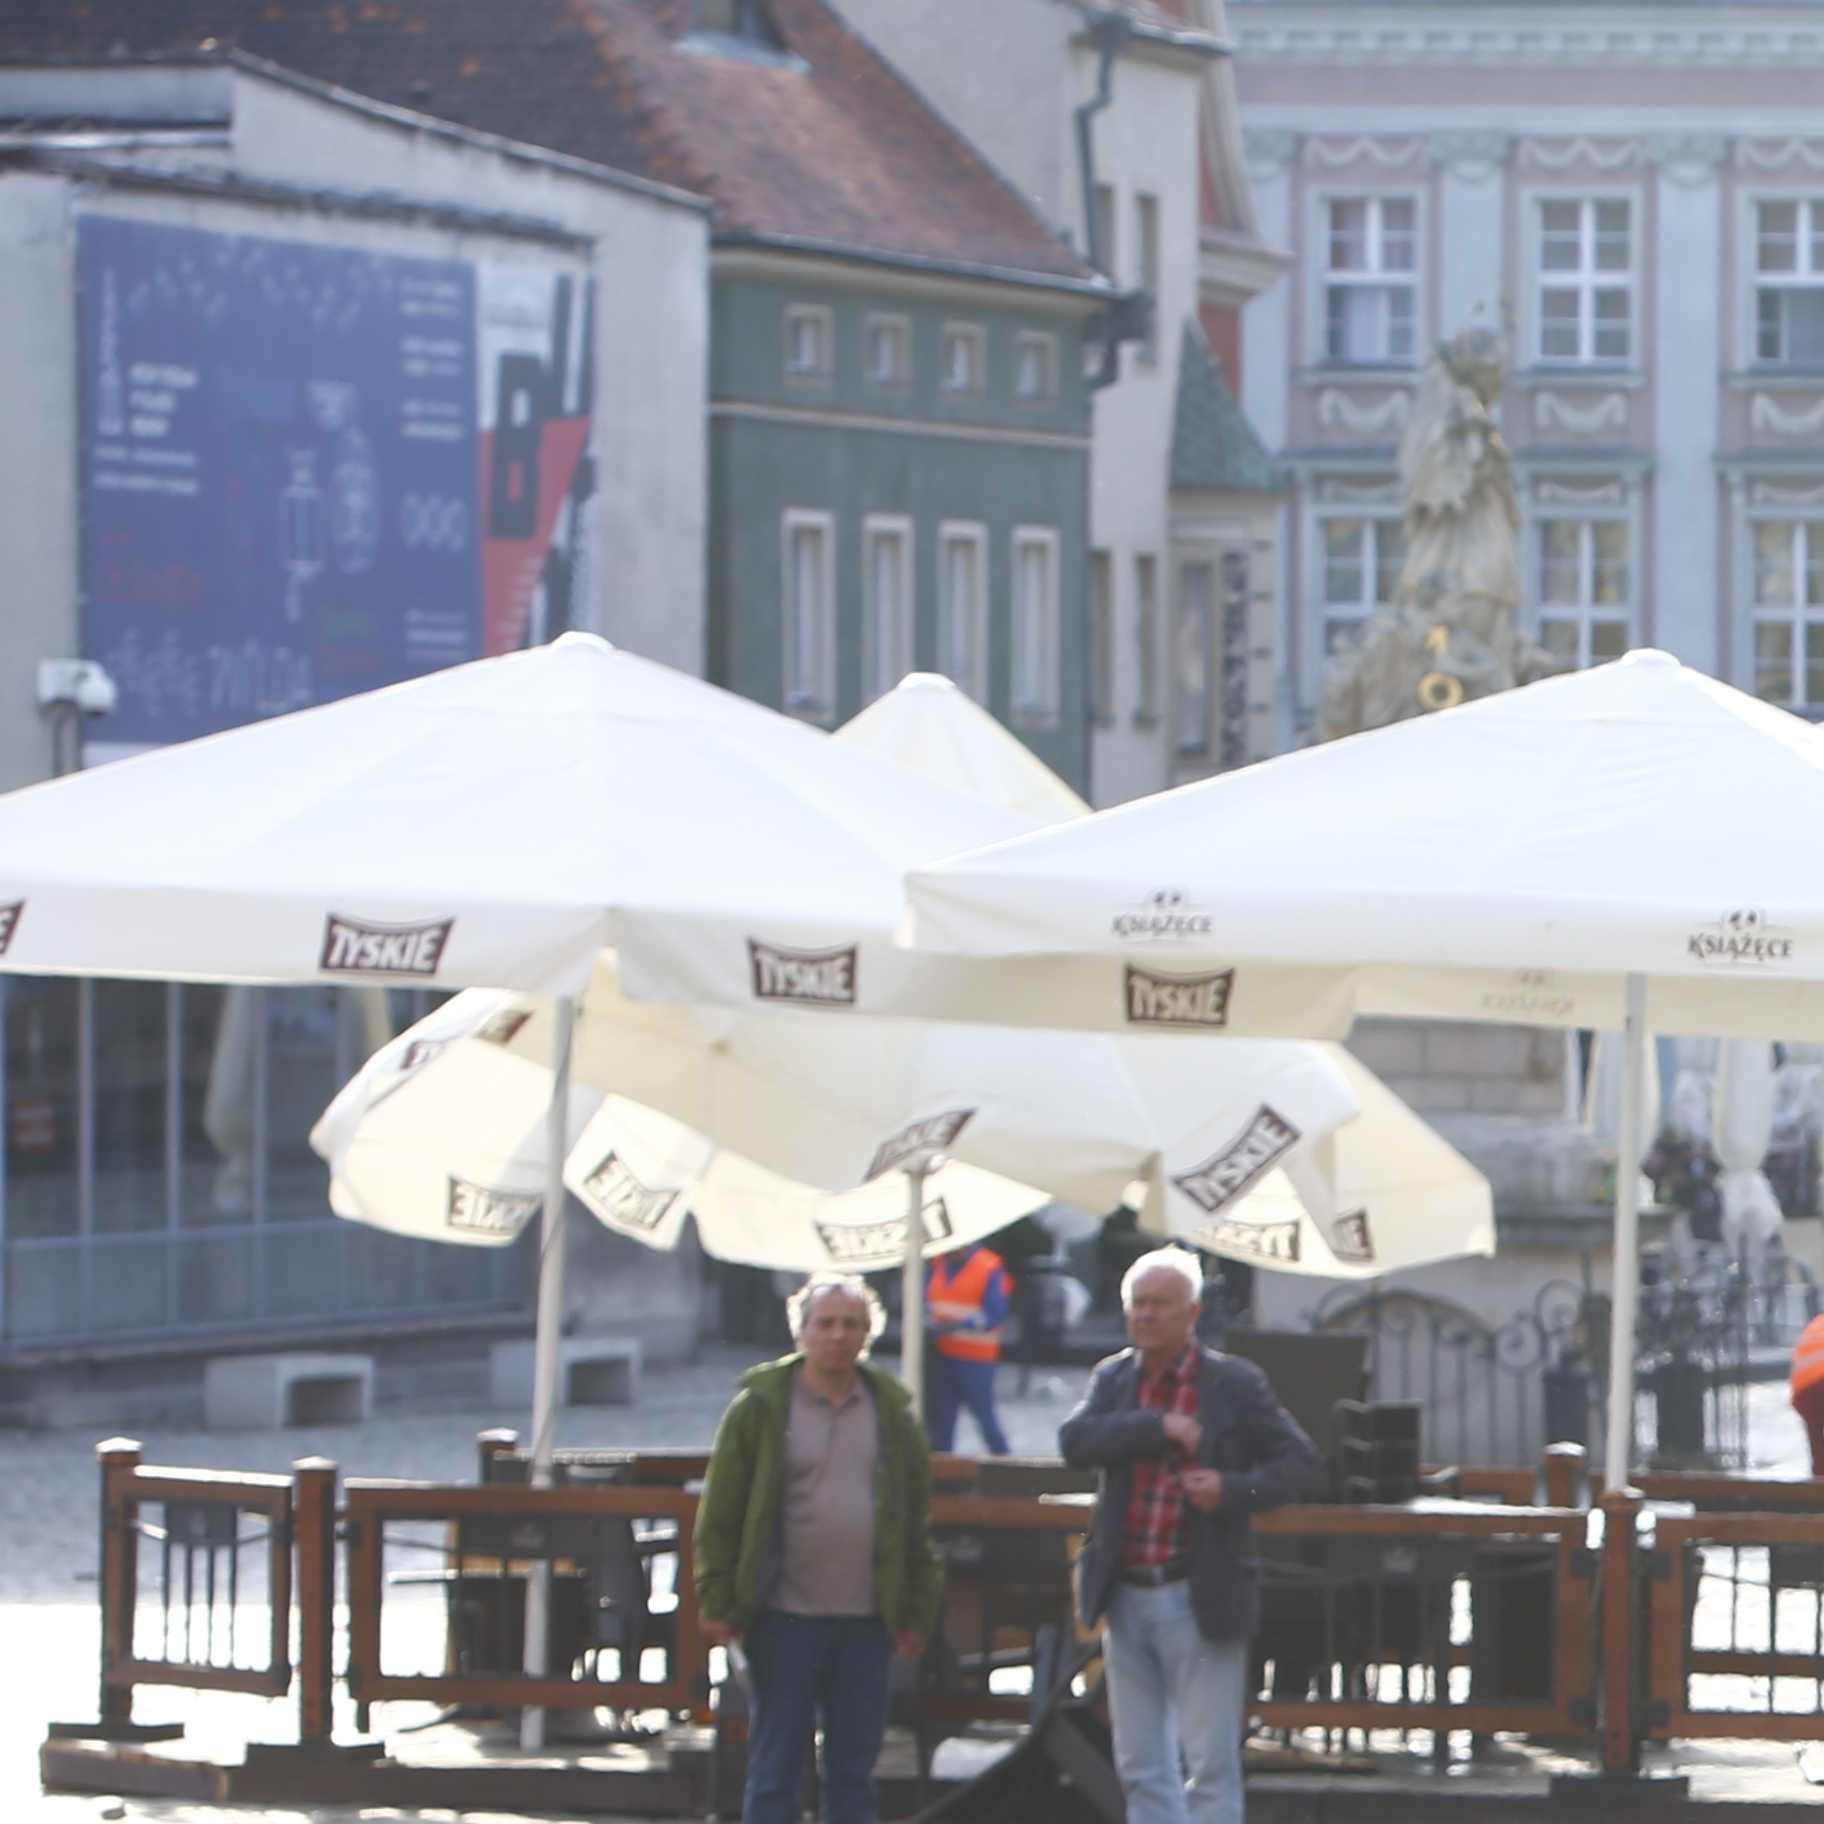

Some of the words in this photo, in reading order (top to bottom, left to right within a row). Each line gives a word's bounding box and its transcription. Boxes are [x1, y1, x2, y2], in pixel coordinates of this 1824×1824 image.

[327, 926, 442, 971] TYSKIE
[1687, 931, 1793, 960] KSIĄŻĘCE
[754, 949, 853, 1001] TYSKIE
[1131, 975, 1226, 1022] TYSKIE
